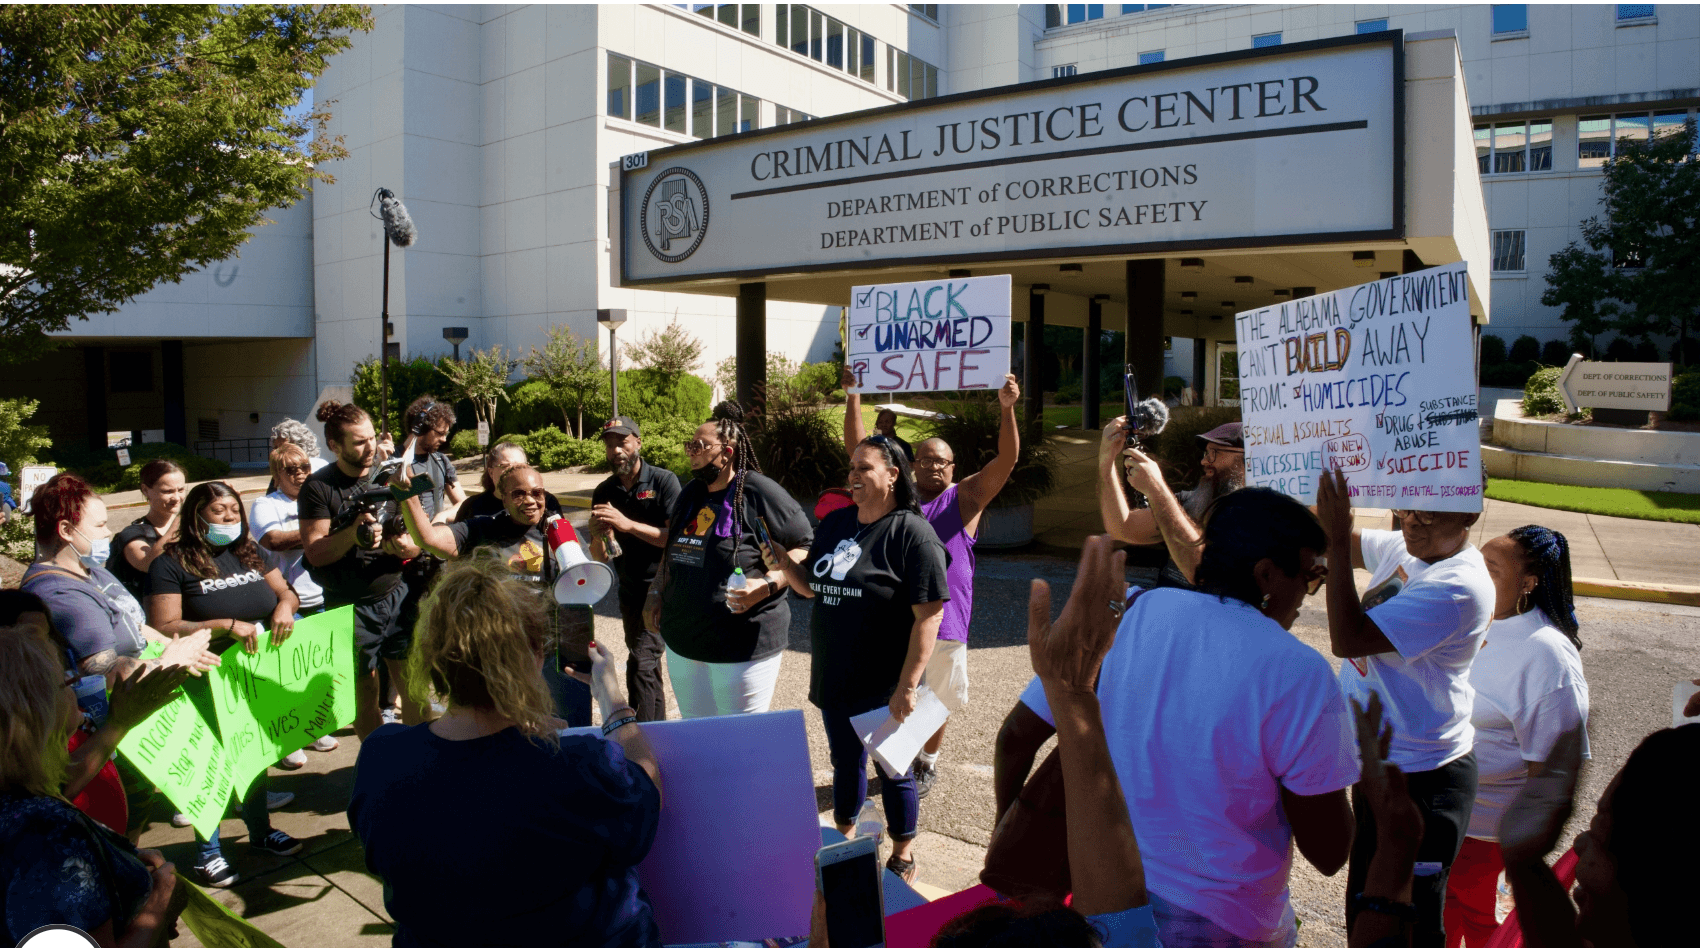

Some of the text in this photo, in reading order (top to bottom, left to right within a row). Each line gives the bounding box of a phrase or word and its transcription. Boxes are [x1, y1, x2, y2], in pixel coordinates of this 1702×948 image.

[751, 76, 1328, 181] CRIMINAL JUSTICE CENTER
[626, 153, 645, 168] 301
[827, 164, 1198, 219] DEPARTMENT of CORRECTIONS
[655, 192, 699, 235] RSA
[820, 201, 1208, 249] DEPARTMENT of PUBLIC SAFETY
[876, 283, 969, 323] BLACK
[1236, 269, 1467, 343] THE ALABAMA GOVERNMENT
[875, 316, 993, 352] UNARMED
[1239, 343, 1278, 379] CAN'T
[1362, 316, 1430, 367] AWAY
[876, 349, 990, 390] SAFE
[1614, 373, 1667, 382] CORRECTIONS
[1242, 371, 1410, 414] FROM: HOMICIDES
[1420, 394, 1476, 413] SUBSTANCE
[1636, 391, 1666, 400] SAFETY
[1250, 418, 1353, 447] SEXUAL ASSUALTS
[1384, 413, 1414, 437] DRUG
[1327, 438, 1363, 453] NO NEW
[1394, 431, 1440, 453] ABUSE
[1252, 450, 1322, 478] EXCESSIVE
[1329, 452, 1366, 471] PRISONS
[1386, 450, 1470, 476] SUICIDE
[33, 472, 46, 482] NO
[1401, 484, 1439, 498] MENTAL
[822, 584, 842, 596] EVERY
[842, 587, 863, 598] CHAIN
[822, 595, 842, 606] RALLY
[277, 630, 335, 689] Loved
[256, 708, 300, 757] Lives
